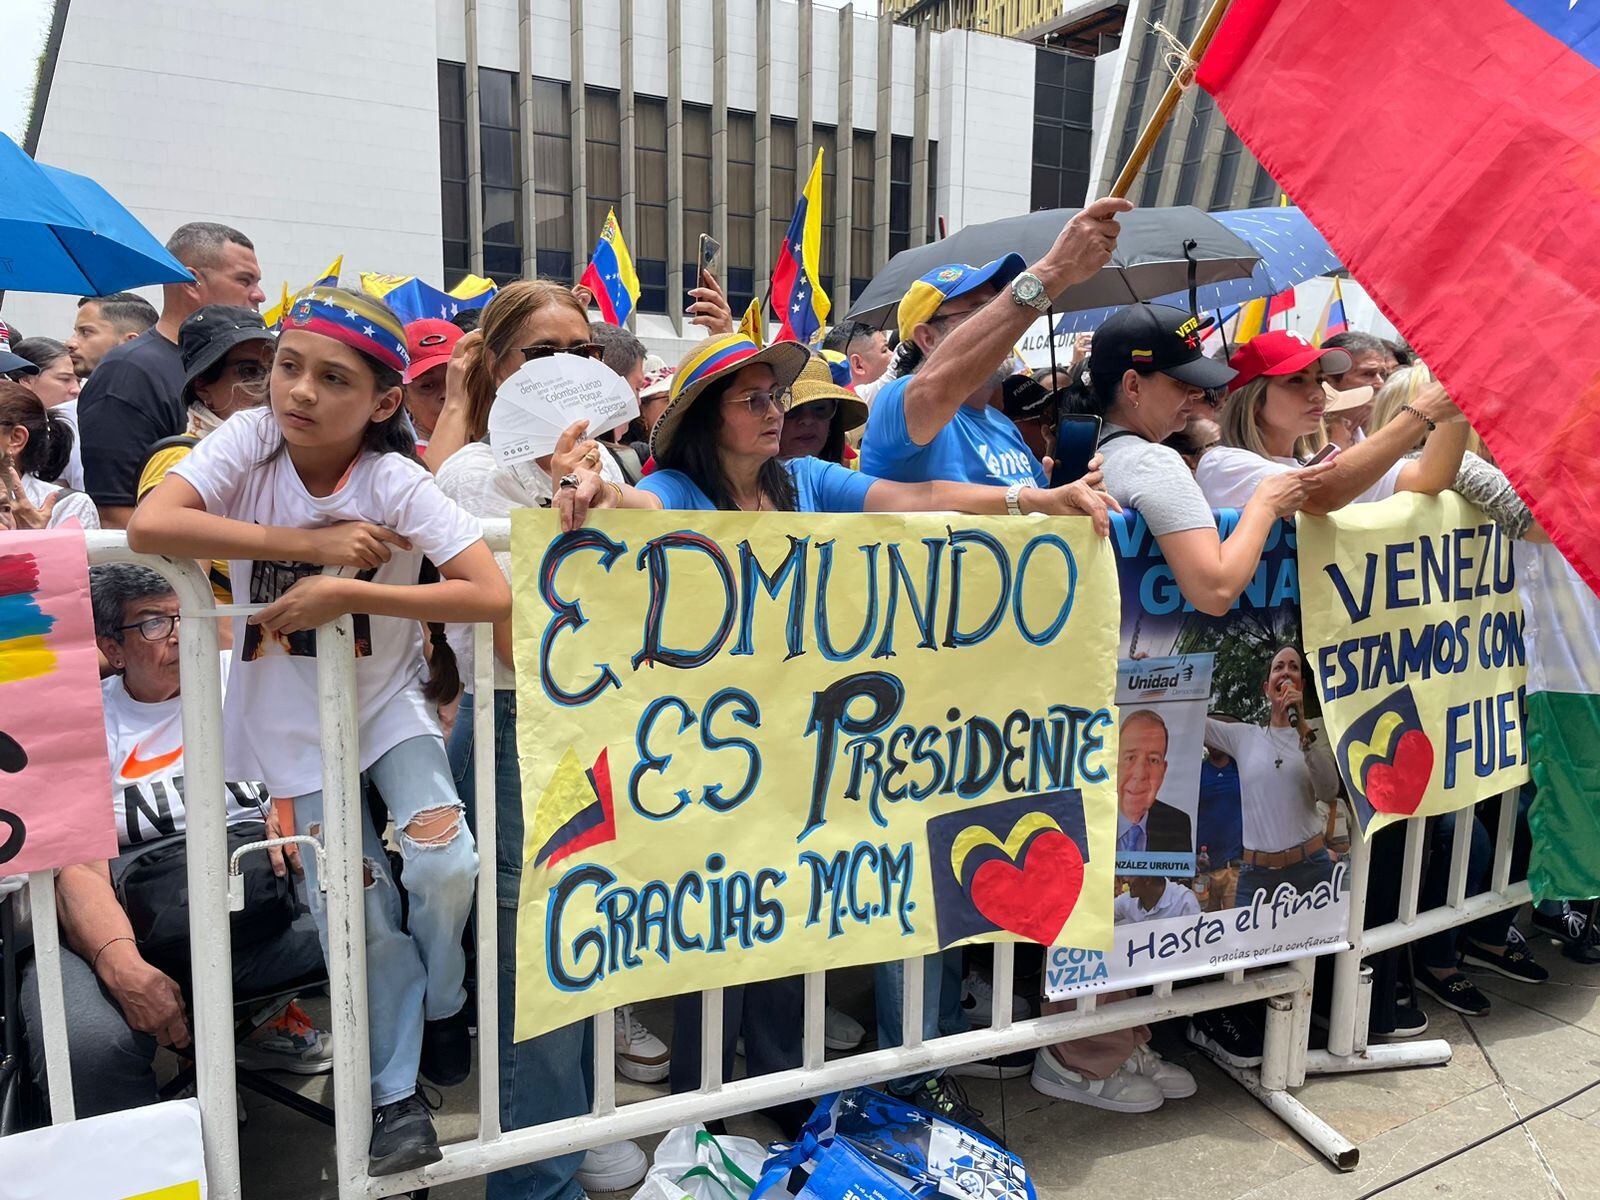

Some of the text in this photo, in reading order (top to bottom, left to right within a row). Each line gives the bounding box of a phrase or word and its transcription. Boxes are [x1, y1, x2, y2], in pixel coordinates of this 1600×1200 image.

[1022, 331, 1076, 351] ALCADIA
[1139, 558, 1299, 616] GNA
[1323, 522, 1515, 624] VENEZU
[538, 525, 1079, 706] EDMUNDO
[1128, 673, 1180, 690] Unidad
[1318, 615, 1471, 704] ESTAMOS
[629, 687, 762, 820] ES
[1149, 862, 1190, 870] URRUTIA
[1127, 864, 1343, 967] Hasta el final
[1053, 947, 1103, 967] CON
[1209, 935, 1340, 966] gracias por la confianza
[1047, 962, 1109, 988] VZLA
